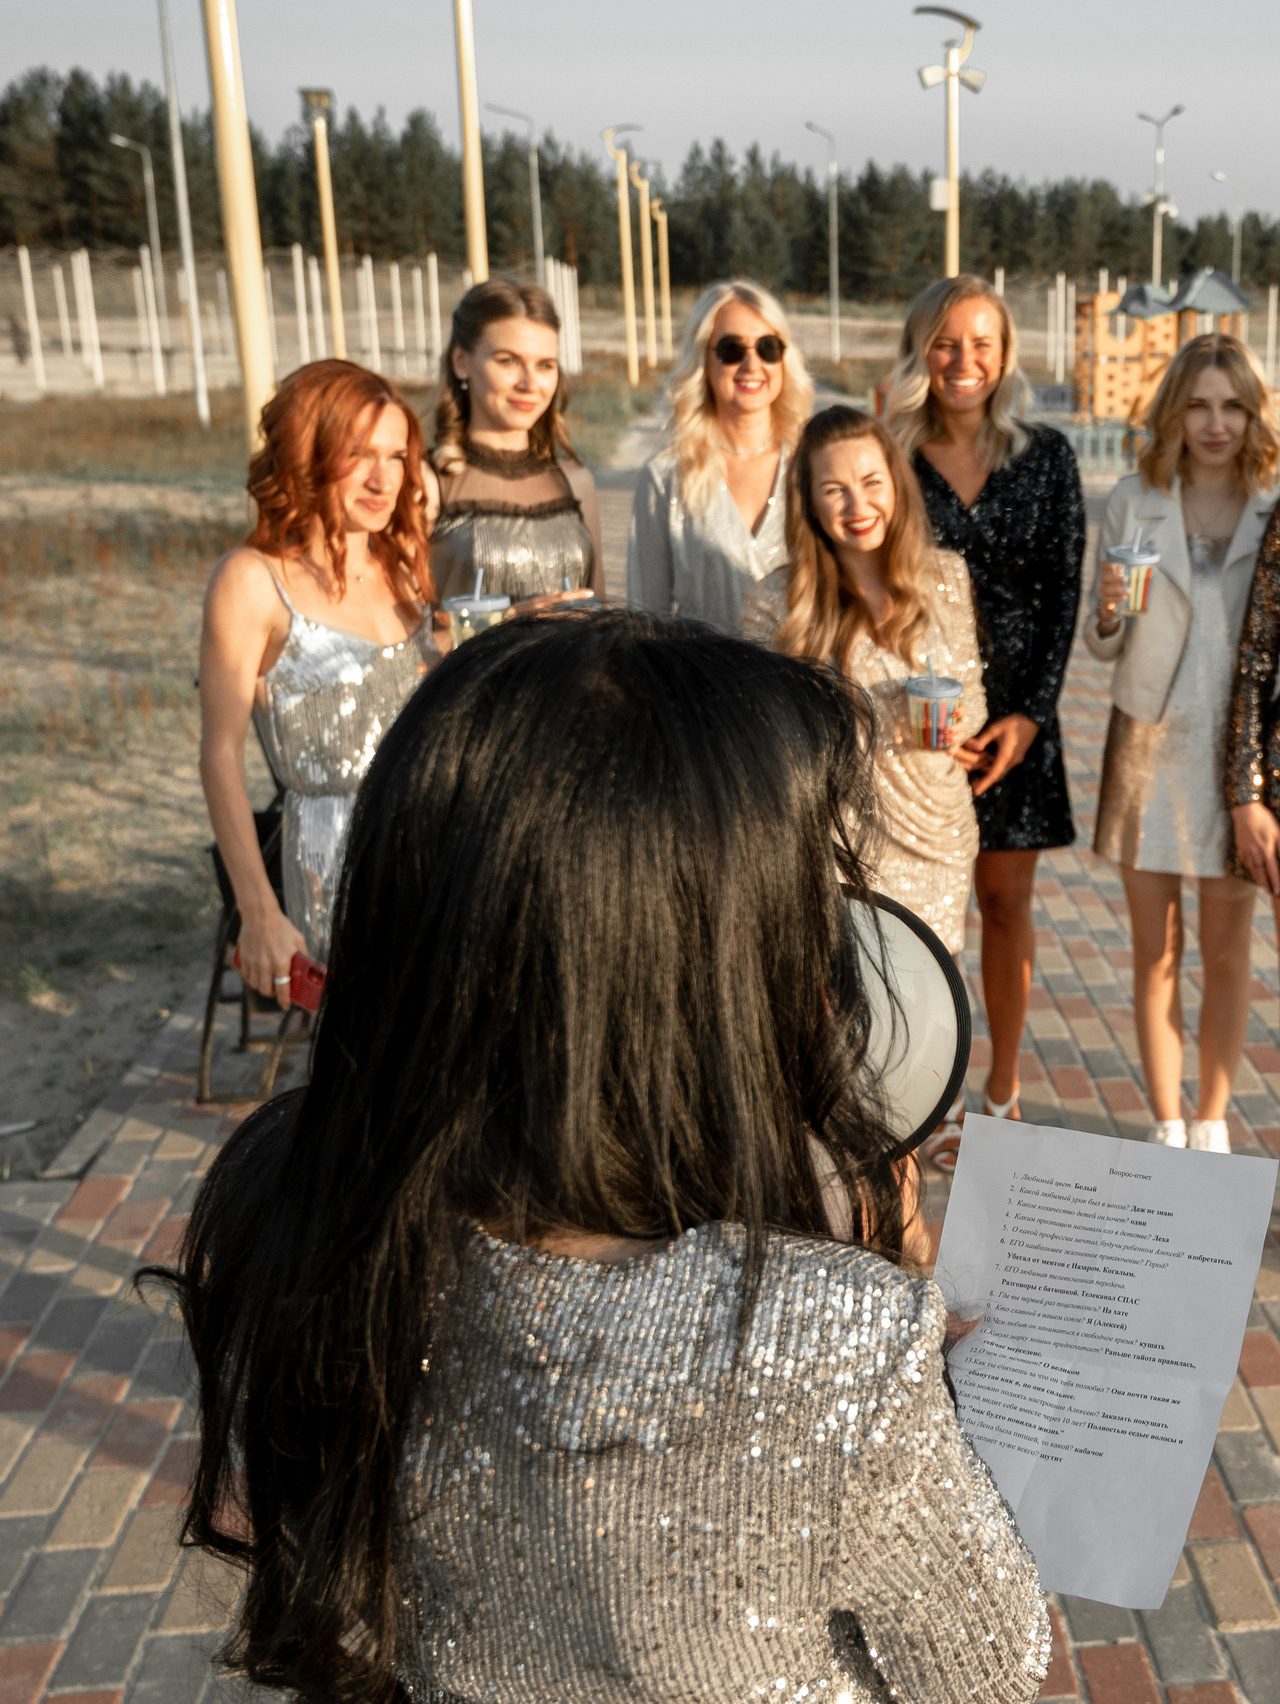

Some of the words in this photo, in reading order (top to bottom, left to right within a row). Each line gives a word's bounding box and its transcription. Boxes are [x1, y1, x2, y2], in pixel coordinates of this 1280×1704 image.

[1021, 1174, 1053, 1185] Любимый
[1075, 1183, 1097, 1192] Белый
[1109, 1168, 1152, 1180] Вопрос-ответ
[1019, 1187, 1039, 1196] Какой
[1040, 1192, 1071, 1201] любимый
[1017, 1200, 1036, 1208] Какое
[1038, 1205, 1075, 1215] количество
[1076, 1211, 1096, 1219] детей
[1014, 1213, 1035, 1222] Каким
[1073, 1224, 1102, 1233] называли
[1120, 1230, 1151, 1240] детстве?
[1009, 1239, 1024, 1247] ЕГО
[1025, 1243, 1062, 1254] наибольшее
[1064, 1249, 1098, 1258] жизненное
[1145, 1260, 1169, 1269] Город?
[1039, 1232, 1073, 1242] профессии
[1100, 1240, 1122, 1249] будучи
[1122, 1244, 1153, 1253] ребенком
[1155, 1248, 1184, 1258] Алексей?
[1188, 1254, 1232, 1265] изобретатель
[1007, 1252, 1030, 1262] Убегал
[1071, 1263, 1101, 1272] Назаром.
[1103, 1267, 1135, 1277] Когалым.
[1019, 1270, 1047, 1278] любимая
[1049, 1274, 1094, 1284] телевизионная
[1001, 1279, 1036, 1290] Разговоры
[1043, 1286, 1079, 1296] батюшкой.
[1081, 1291, 1115, 1301] Телеканал
[1117, 1296, 1140, 1305] СПАС
[1021, 1297, 1044, 1305] первый
[995, 1304, 1009, 1312] Кто
[1010, 1308, 1036, 1316] главный
[1042, 1313, 1062, 1321] вашем
[1094, 1320, 1127, 1331] (Алексей)
[983, 1340, 1006, 1349] сейчас
[1006, 1320, 1027, 1328] любит
[1038, 1326, 1074, 1336] заниматься
[1081, 1332, 1113, 1341] свободное
[1115, 1336, 1138, 1346] время?
[1139, 1342, 1165, 1350] кушать
[1009, 1334, 1029, 1342] марку
[1053, 1341, 1103, 1353] предпочитает?
[1105, 1348, 1131, 1358] Раньше
[1158, 1358, 1196, 1368] нравилась,
[997, 1365, 1027, 1375] считаешь
[1075, 1383, 1105, 1392] полюбил
[1051, 1366, 1080, 1375] великом
[969, 1371, 999, 1380] ебанутая
[1046, 1389, 1075, 1400] сильнее.
[959, 1390, 971, 1398] Как
[982, 1398, 1002, 1406] видит
[1019, 1407, 1041, 1417] вместе
[1043, 1414, 1060, 1422] через
[1087, 1423, 1127, 1434] Полностью
[1129, 1430, 1149, 1438] седые
[1151, 1435, 1176, 1443] волосы
[978, 1384, 999, 1393] можно
[1001, 1390, 1027, 1400] поднять
[1028, 1397, 1065, 1410] настроение
[1067, 1406, 1100, 1417] Алексею?
[1101, 1412, 1132, 1422] Заказать
[1133, 1418, 1168, 1428] покушать
[986, 1411, 1006, 1420] будто
[1007, 1417, 1036, 1428] повидал
[966, 1417, 976, 1425] бы
[977, 1421, 993, 1430] Лена
[995, 1426, 1012, 1435] была
[1050, 1443, 1073, 1451] какой?
[1074, 1447, 1104, 1457] кабачок
[975, 1434, 998, 1444] делает
[999, 1441, 1015, 1450] хуже
[1017, 1446, 1039, 1455] всего?
[1040, 1453, 1063, 1462] шутит
